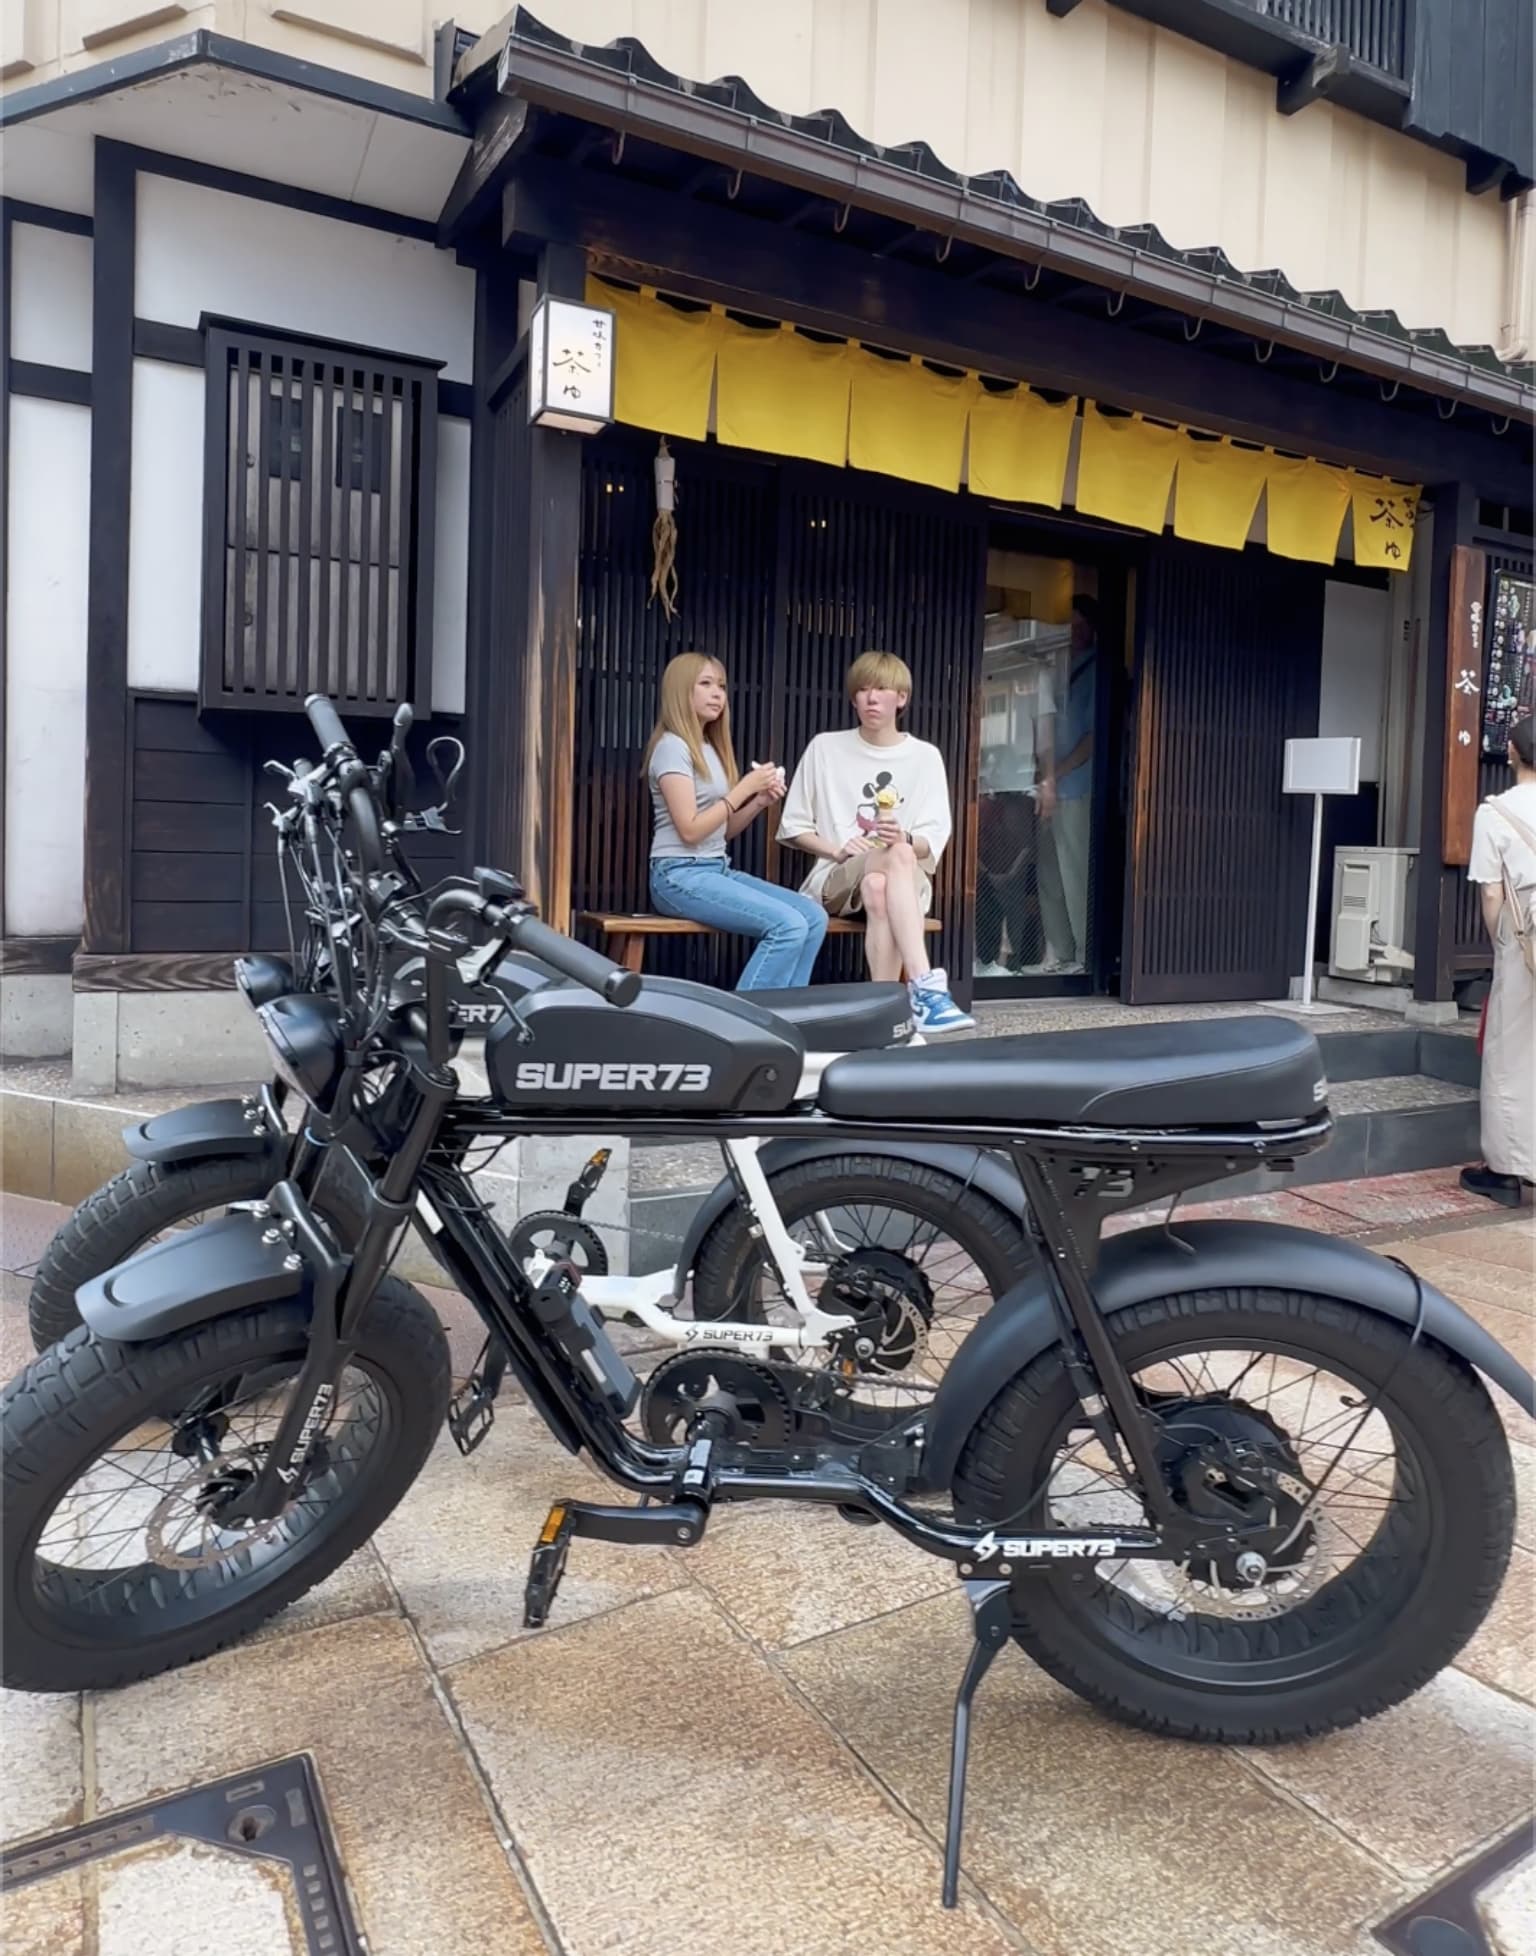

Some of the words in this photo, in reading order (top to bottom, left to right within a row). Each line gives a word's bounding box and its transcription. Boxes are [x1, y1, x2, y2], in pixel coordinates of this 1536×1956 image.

[516, 1063, 711, 1091] SUPER73
[703, 1329, 774, 1342] SUPER73
[290, 1384, 334, 1463] SUPER73
[1003, 1539, 1117, 1557] SUPER73
